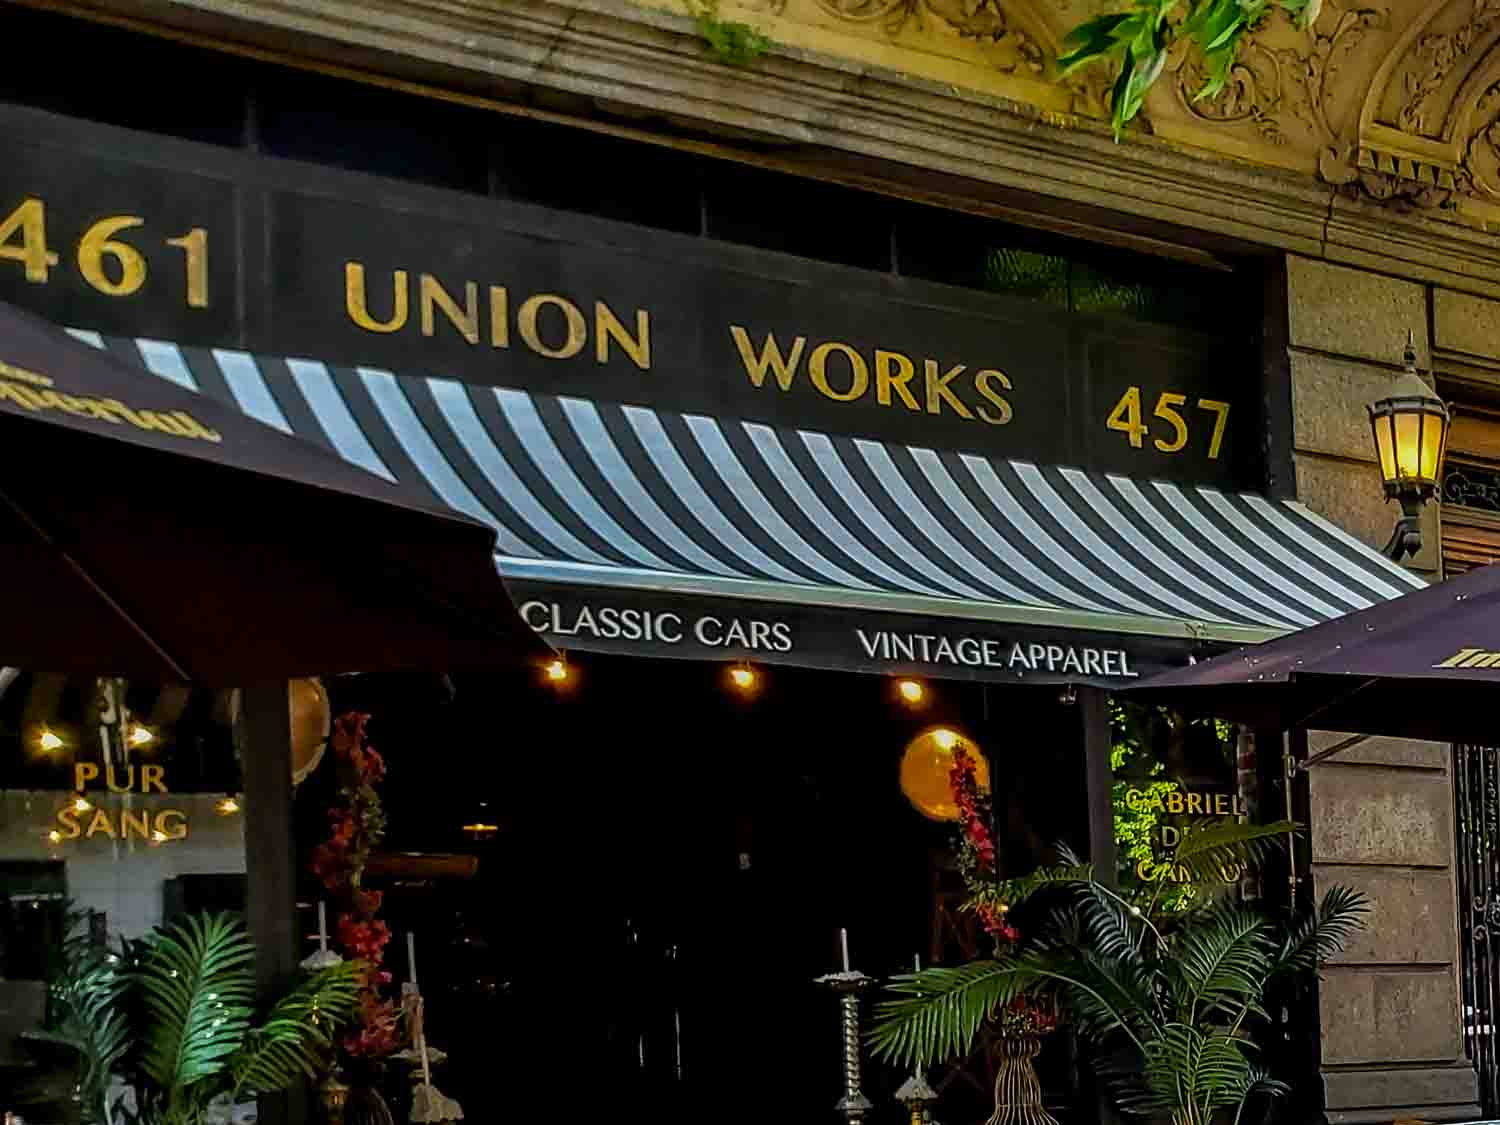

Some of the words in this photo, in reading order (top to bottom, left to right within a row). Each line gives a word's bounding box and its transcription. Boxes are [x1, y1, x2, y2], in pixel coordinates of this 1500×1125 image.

[0, 197, 209, 308] 461
[345, 261, 651, 370] UNION
[730, 325, 1013, 426] WORKS
[1106, 386, 1231, 460] 457
[519, 600, 683, 643] CLASSIC
[695, 615, 793, 652] CARS
[856, 628, 1003, 668] VINTAGE
[1008, 641, 1139, 678] APPAREL
[74, 761, 169, 793] PUR
[1125, 788, 1248, 816] GABRIEL
[56, 806, 188, 840] SANG
